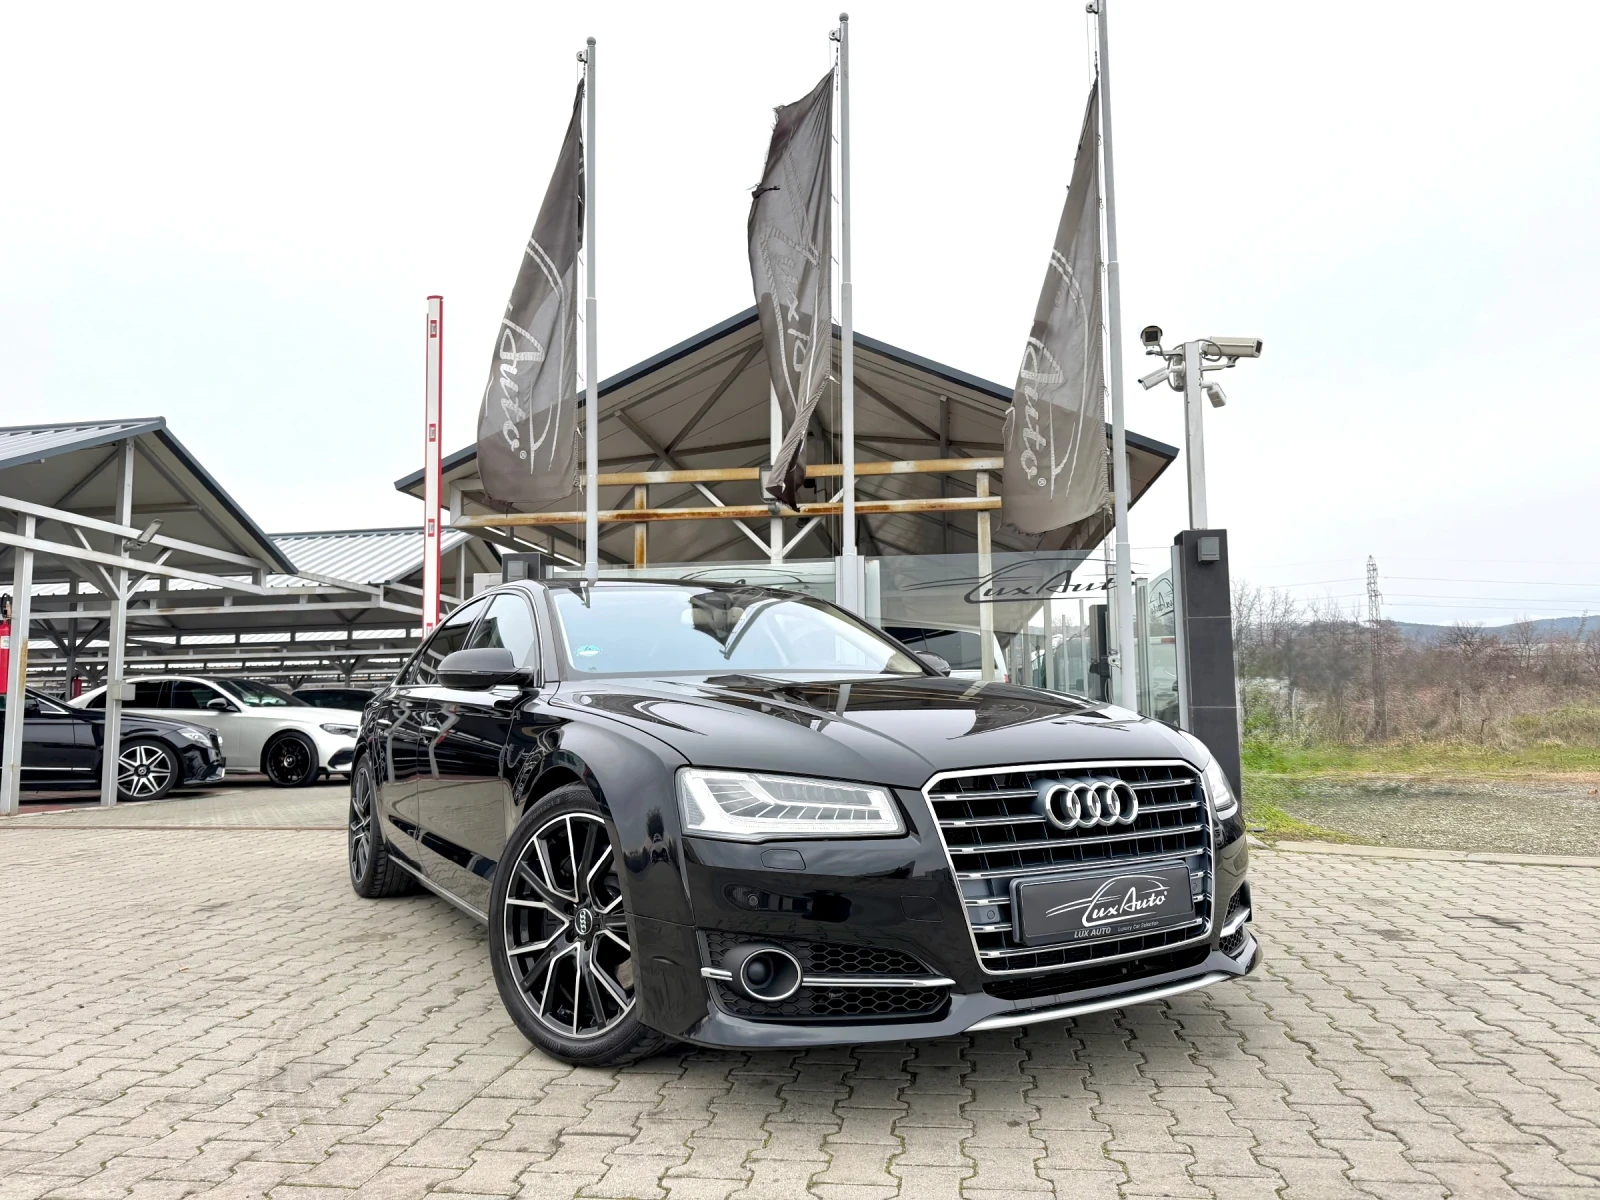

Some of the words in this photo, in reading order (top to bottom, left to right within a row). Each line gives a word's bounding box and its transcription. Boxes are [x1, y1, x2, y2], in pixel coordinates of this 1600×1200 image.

[1035, 570, 1137, 594] Aut
[1082, 898, 1119, 927] Lux
[1074, 929, 1089, 938] LUX
[1090, 926, 1112, 937] AUTO
